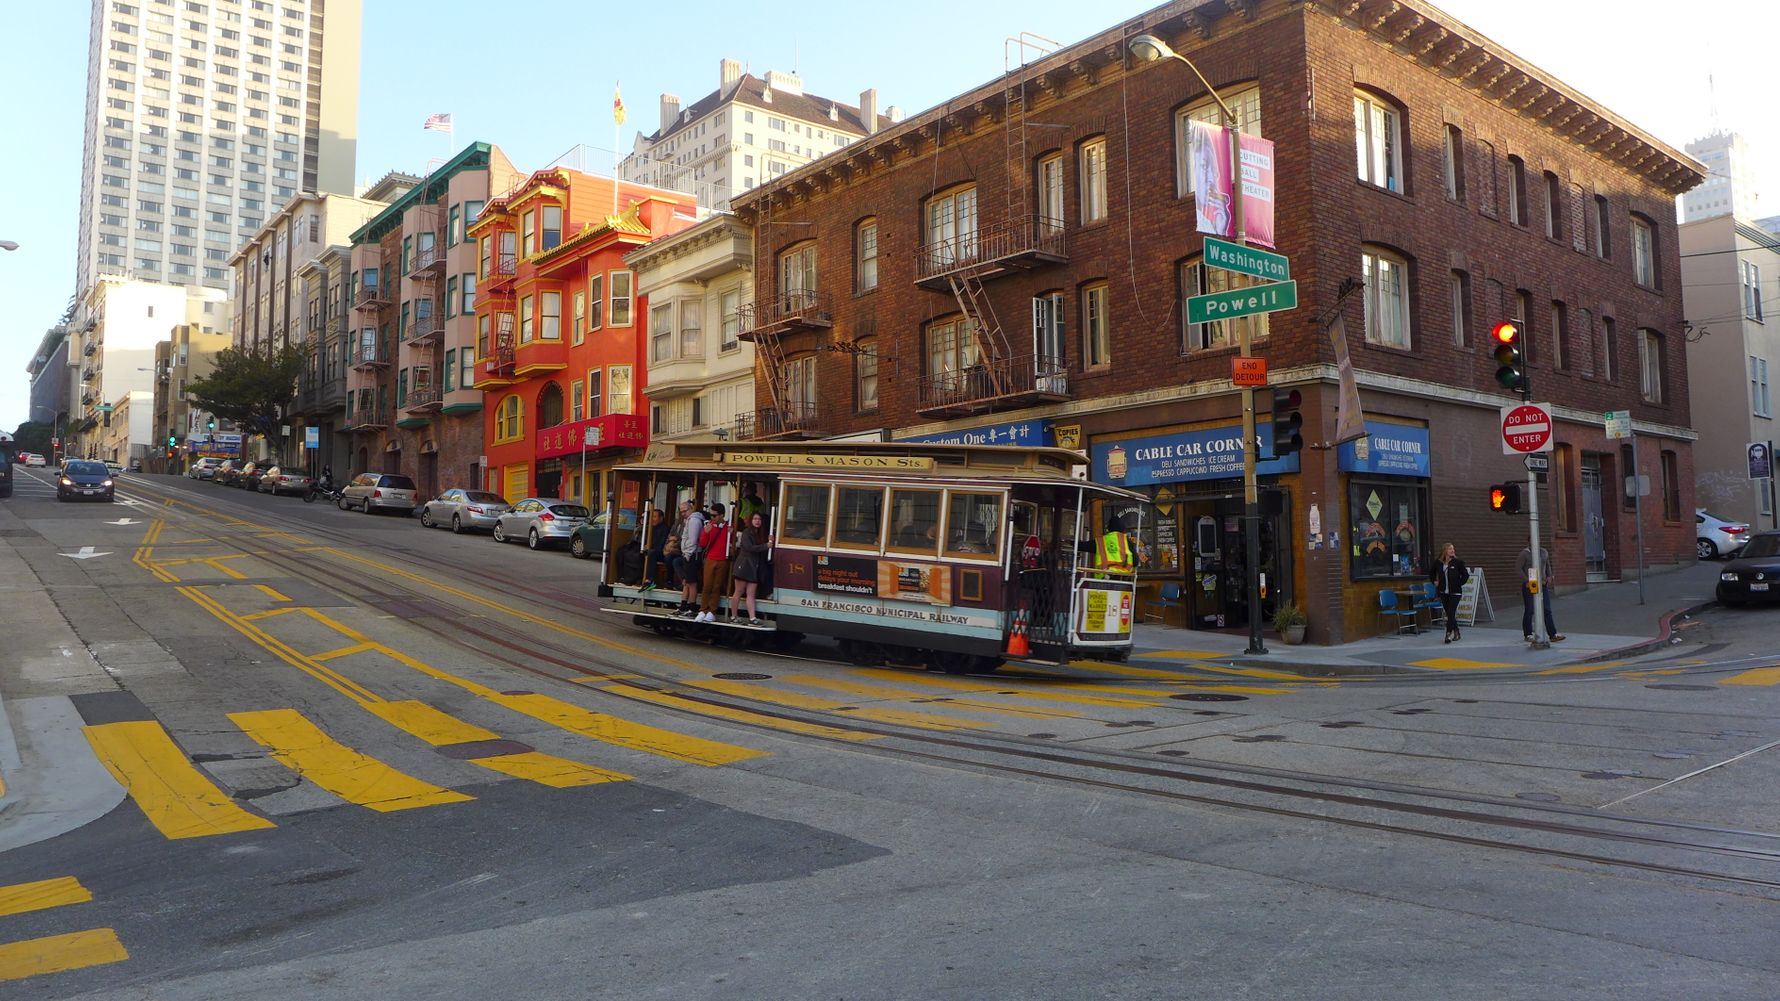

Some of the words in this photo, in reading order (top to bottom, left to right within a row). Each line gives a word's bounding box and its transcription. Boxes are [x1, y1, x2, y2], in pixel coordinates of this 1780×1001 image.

[1209, 244, 1285, 275] Washington
[1206, 290, 1276, 315] Powell
[1241, 362, 1257, 370] END
[1235, 373, 1265, 381] DETOUR
[1508, 415, 1520, 424] DO
[1525, 413, 1543, 423] NOT
[1058, 428, 1079, 436] COPIES
[922, 437, 960, 445] stom
[964, 433, 986, 445] One
[1374, 437, 1390, 451] CABLE
[1390, 439, 1400, 452] CAR
[1401, 440, 1421, 454] CORNER
[1513, 434, 1541, 445] ENTER
[1135, 446, 1173, 461] CABLE
[1176, 442, 1202, 456] CAR
[1206, 435, 1263, 453] CORNR
[732, 454, 799, 464] POWELL
[805, 456, 816, 465] &
[823, 457, 889, 467] MASON
[897, 458, 924, 468] Sts.
[1161, 460, 1173, 468] DELI
[1174, 457, 1206, 467] SANDWICHES
[1208, 456, 1216, 464] ICE
[1217, 454, 1236, 463] CREAM
[1152, 469, 1175, 478] ESPRESSO
[1176, 466, 1208, 476] CAPPUCCINO
[1210, 464, 1226, 473] FRESH
[788, 562, 805, 574] 18
[817, 582, 845, 591] breakfast
[845, 585, 873, 594] shouldn't
[801, 599, 819, 608] SAN
[822, 601, 873, 614] FRANCISCO
[876, 605, 925, 620] MUNICIPAL
[929, 613, 969, 625] RAILWAY
[1108, 604, 1118, 617] 18
